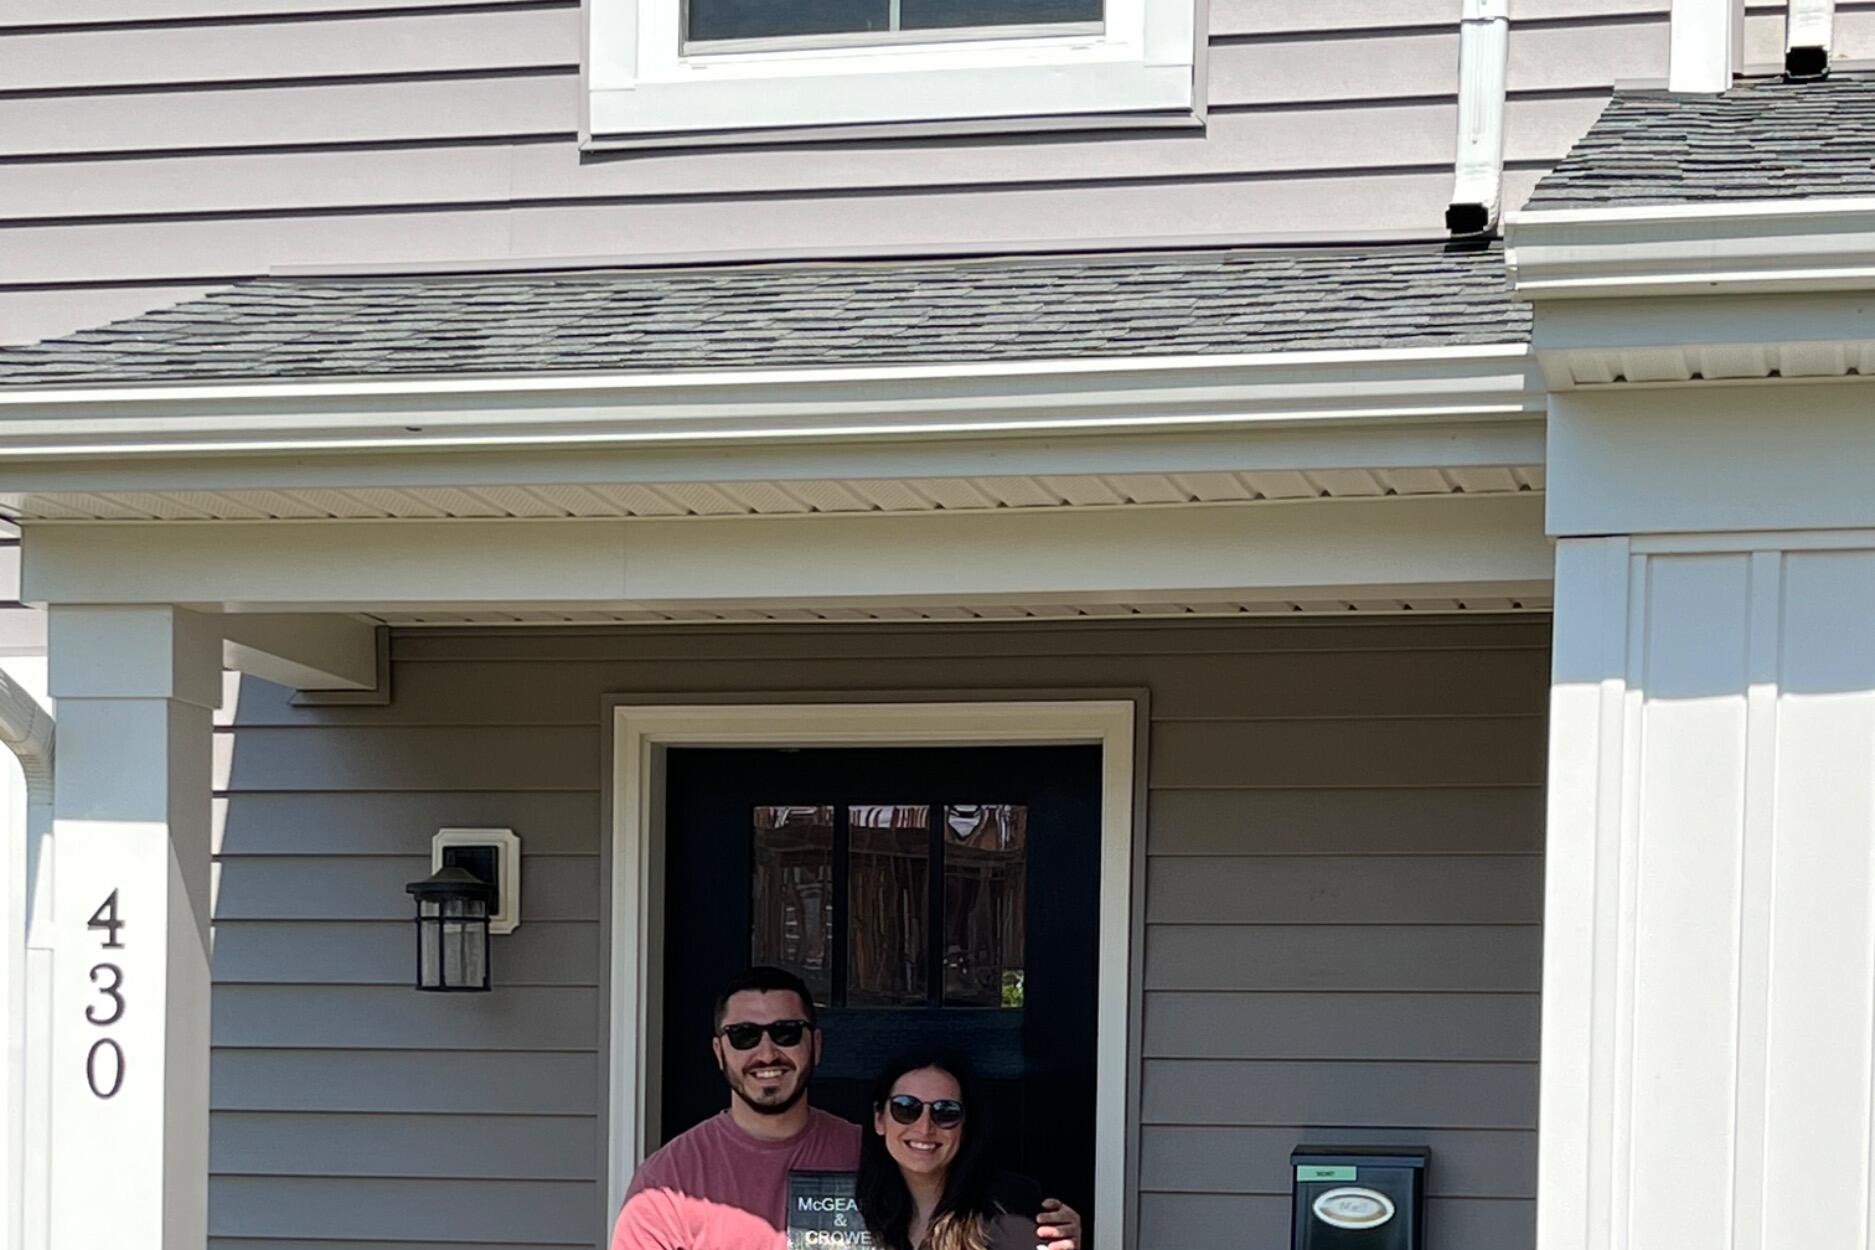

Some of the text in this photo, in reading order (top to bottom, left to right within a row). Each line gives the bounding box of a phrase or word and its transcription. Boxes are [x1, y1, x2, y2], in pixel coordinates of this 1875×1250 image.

[86, 887, 126, 1099] 430
[798, 1197, 858, 1211] McGEA
[834, 1213, 847, 1227] &
[806, 1231, 872, 1245] CROWE
